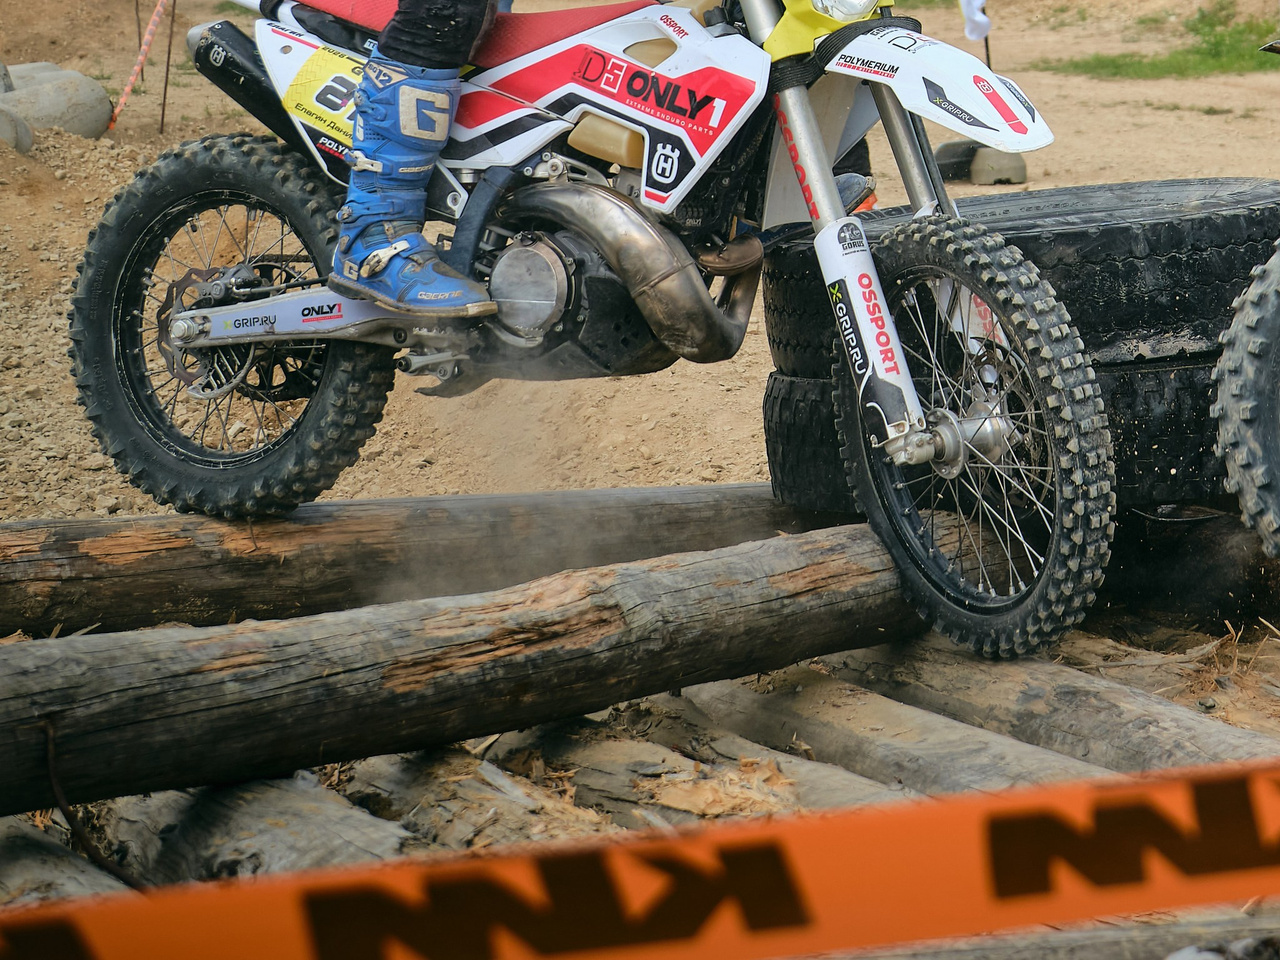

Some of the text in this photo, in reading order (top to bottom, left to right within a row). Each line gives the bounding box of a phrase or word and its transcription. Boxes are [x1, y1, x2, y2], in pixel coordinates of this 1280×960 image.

[659, 14, 690, 39] OSSPORT
[838, 54, 900, 74] POLYMERIUM
[626, 70, 727, 129] ONLY1
[294, 102, 328, 125] Елагин
[626, 98, 715, 136] EXTREME ENDURO PARTS
[842, 240, 865, 251] GORUS
[301, 303, 343, 318] ONLY1
[857, 272, 901, 376] OSSPORT
